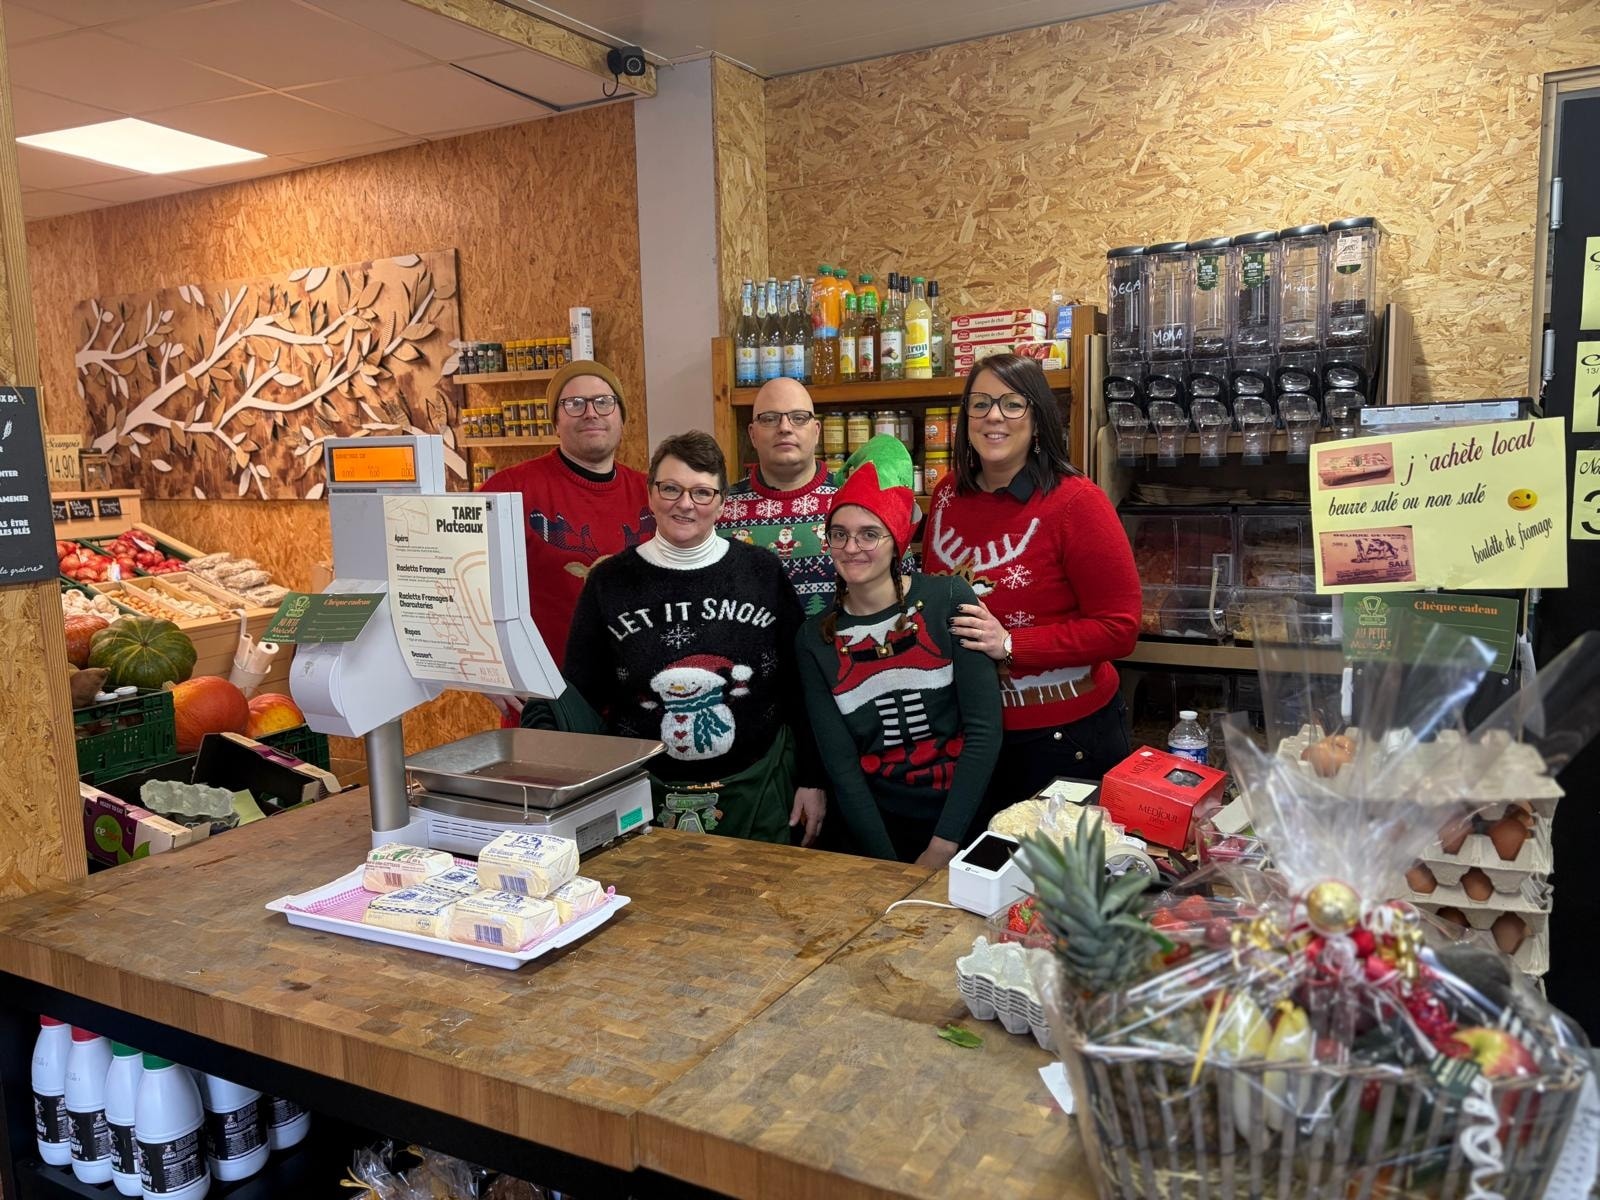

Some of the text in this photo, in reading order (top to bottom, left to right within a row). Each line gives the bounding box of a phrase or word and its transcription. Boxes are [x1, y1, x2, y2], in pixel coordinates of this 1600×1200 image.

[1152, 328, 1183, 344] MOKA
[1491, 421, 1535, 457] local
[1328, 482, 1487, 517] beurre salé ou non salé
[452, 506, 482, 520] TARIF
[11, 518, 29, 527] ÊTRE
[436, 519, 483, 534] Plateaux
[1471, 517, 1554, 564] boulette de fromage
[396, 563, 446, 575] Raclette Fromages
[398, 591, 421, 601] Raclette
[421, 594, 449, 604] Fromages
[399, 600, 434, 609] Charcuteries
[1414, 600, 1498, 615] Chèque cadeau
[607, 597, 776, 642] LET IT SNOW
[411, 650, 433, 659] Dessert
